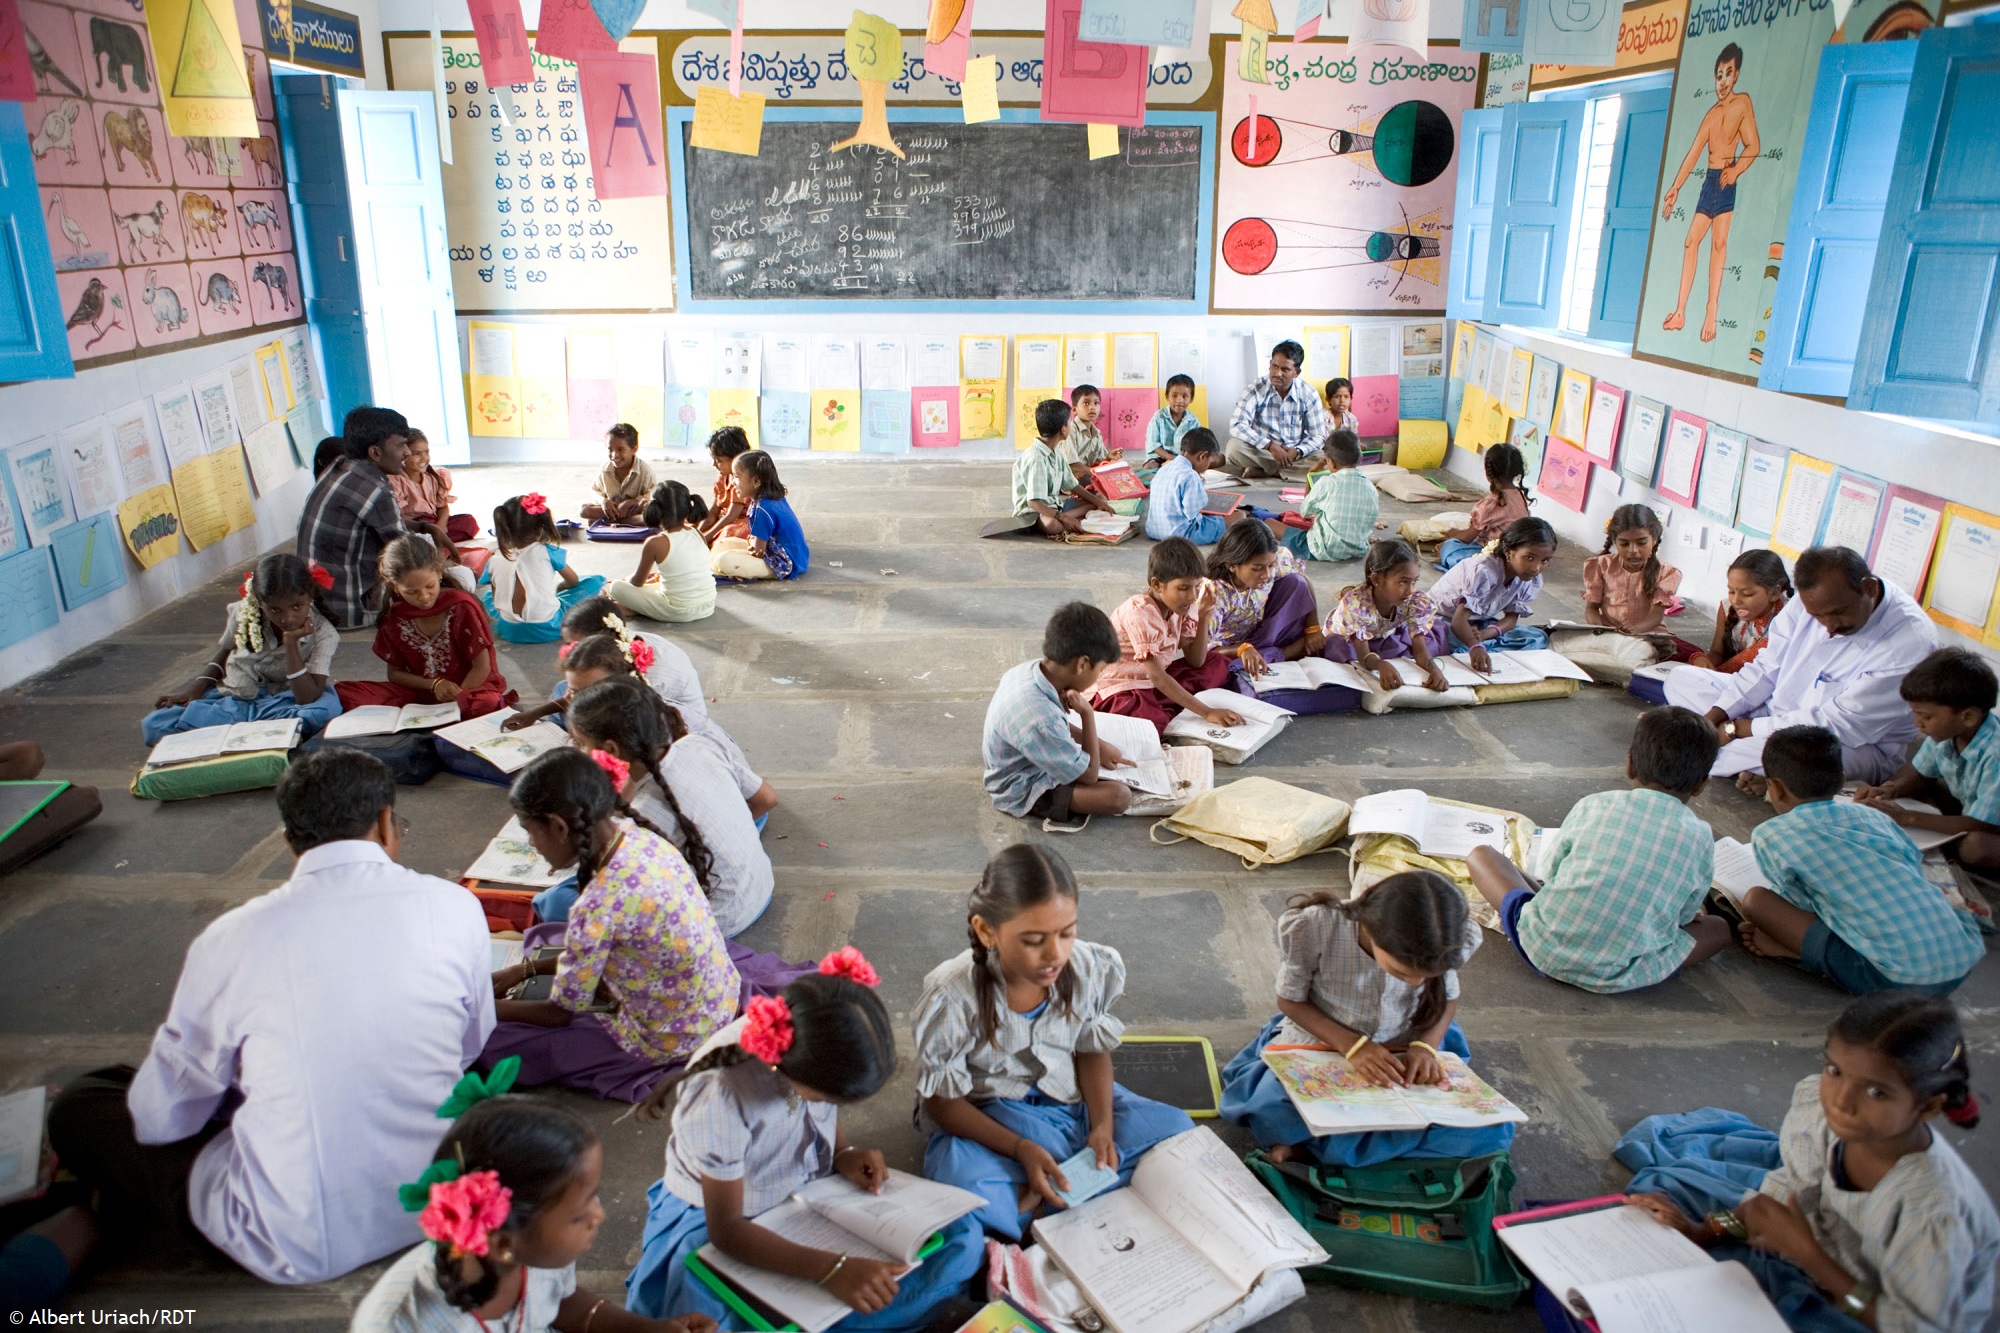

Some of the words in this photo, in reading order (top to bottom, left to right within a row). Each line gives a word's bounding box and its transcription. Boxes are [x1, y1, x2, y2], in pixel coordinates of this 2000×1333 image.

[482, 13, 522, 59] M
[534, 76, 547, 93] ఉ
[467, 101, 481, 118] ఏ
[536, 99, 549, 118] ఓ
[492, 124, 503, 142] క
[515, 128, 532, 144] ఖ
[538, 124, 551, 142] గ
[603, 83, 656, 168] A
[809, 142, 821, 158] 2
[495, 151, 510, 166] చ
[518, 151, 533, 168] ఛ
[539, 152, 554, 166] జ
[808, 163, 820, 176] 4
[495, 173, 512, 189] ట
[519, 174, 531, 189] ఠ
[811, 178, 820, 190] 6
[497, 197, 511, 213] త
[520, 196, 534, 213] థ
[544, 196, 559, 213] ద
[566, 196, 580, 216] ధ
[813, 193, 822, 205] 8
[953, 195, 981, 210] 533
[501, 219, 516, 237] ప
[523, 219, 539, 238] ఫ
[545, 222, 561, 237] బ
[568, 220, 584, 237] భ
[589, 220, 613, 236] మ
[838, 225, 863, 242] 86
[479, 244, 493, 261] ర
[502, 247, 518, 261] ల
[524, 243, 541, 260] వ
[547, 243, 563, 260] శ
[569, 242, 586, 262] ష
[591, 241, 608, 259] స
[613, 240, 638, 259] హ
[838, 245, 867, 258] 92
[839, 259, 863, 272] 43
